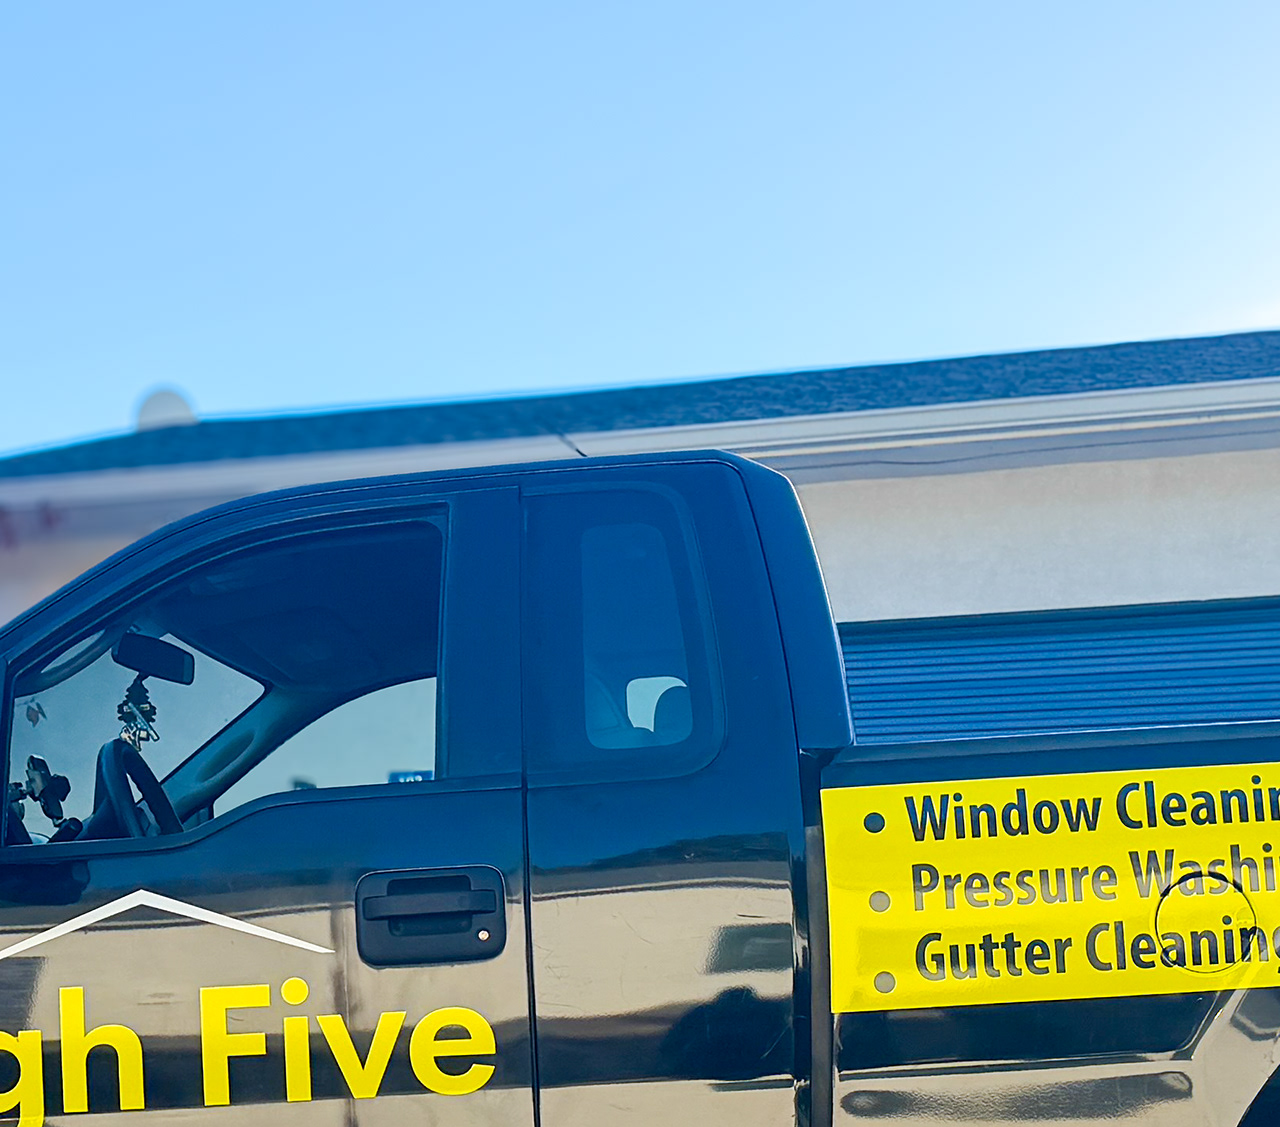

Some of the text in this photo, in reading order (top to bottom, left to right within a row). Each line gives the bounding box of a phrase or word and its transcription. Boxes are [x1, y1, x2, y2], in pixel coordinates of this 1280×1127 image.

[904, 787, 1103, 842] Window
[911, 862, 1119, 912] Pressure
[915, 931, 1073, 981] Gutter
[200, 978, 497, 1106] Five
